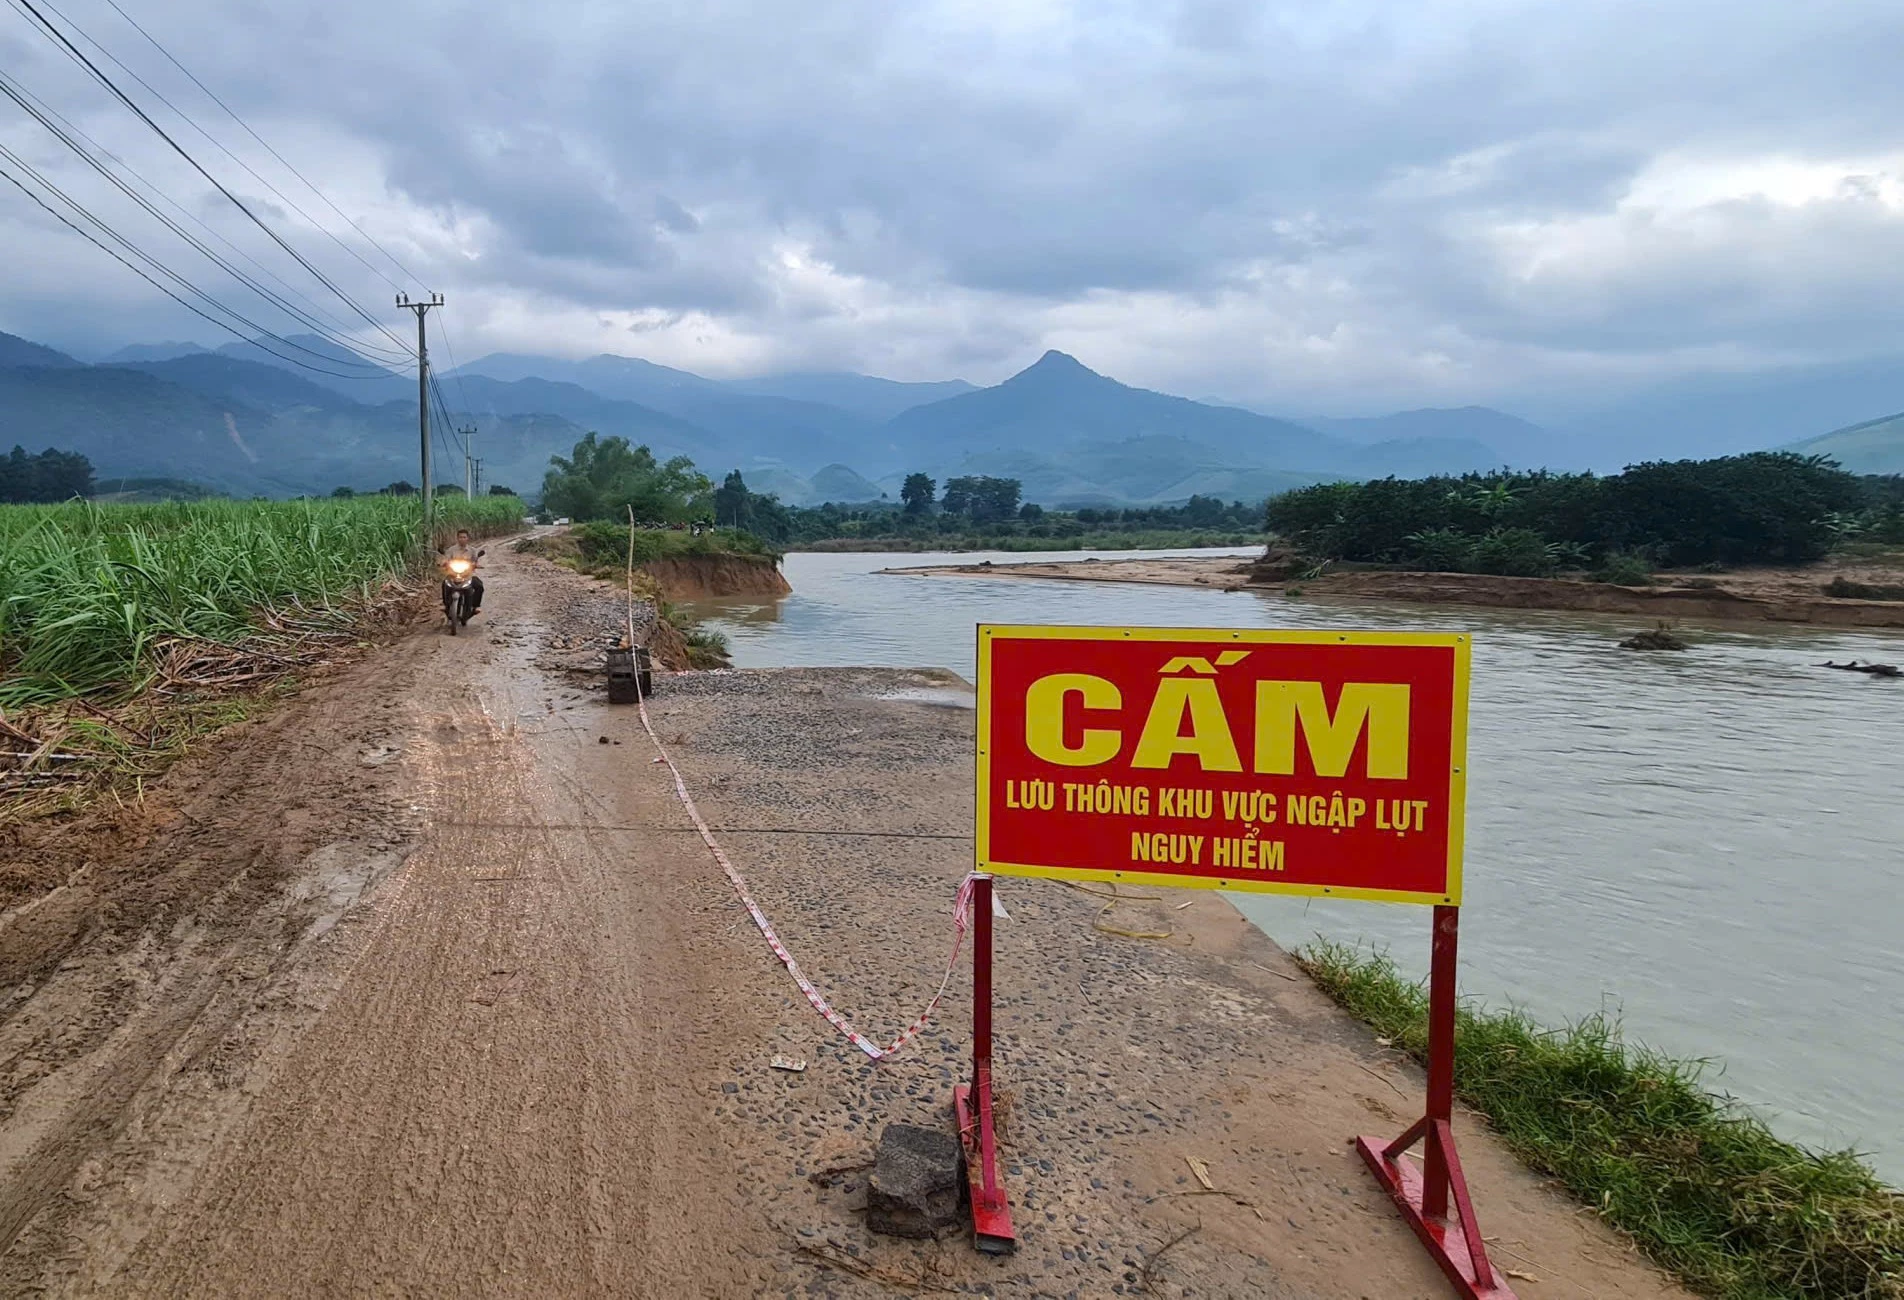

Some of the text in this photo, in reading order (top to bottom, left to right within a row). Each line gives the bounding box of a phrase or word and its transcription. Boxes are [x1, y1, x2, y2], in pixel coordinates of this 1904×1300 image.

[1025, 651, 1410, 779] CẤM
[1006, 779, 1428, 837] LƯU THÔNG KHU VỰC NGẬP LỤT
[1131, 828, 1286, 871] NGUY HIỂM
